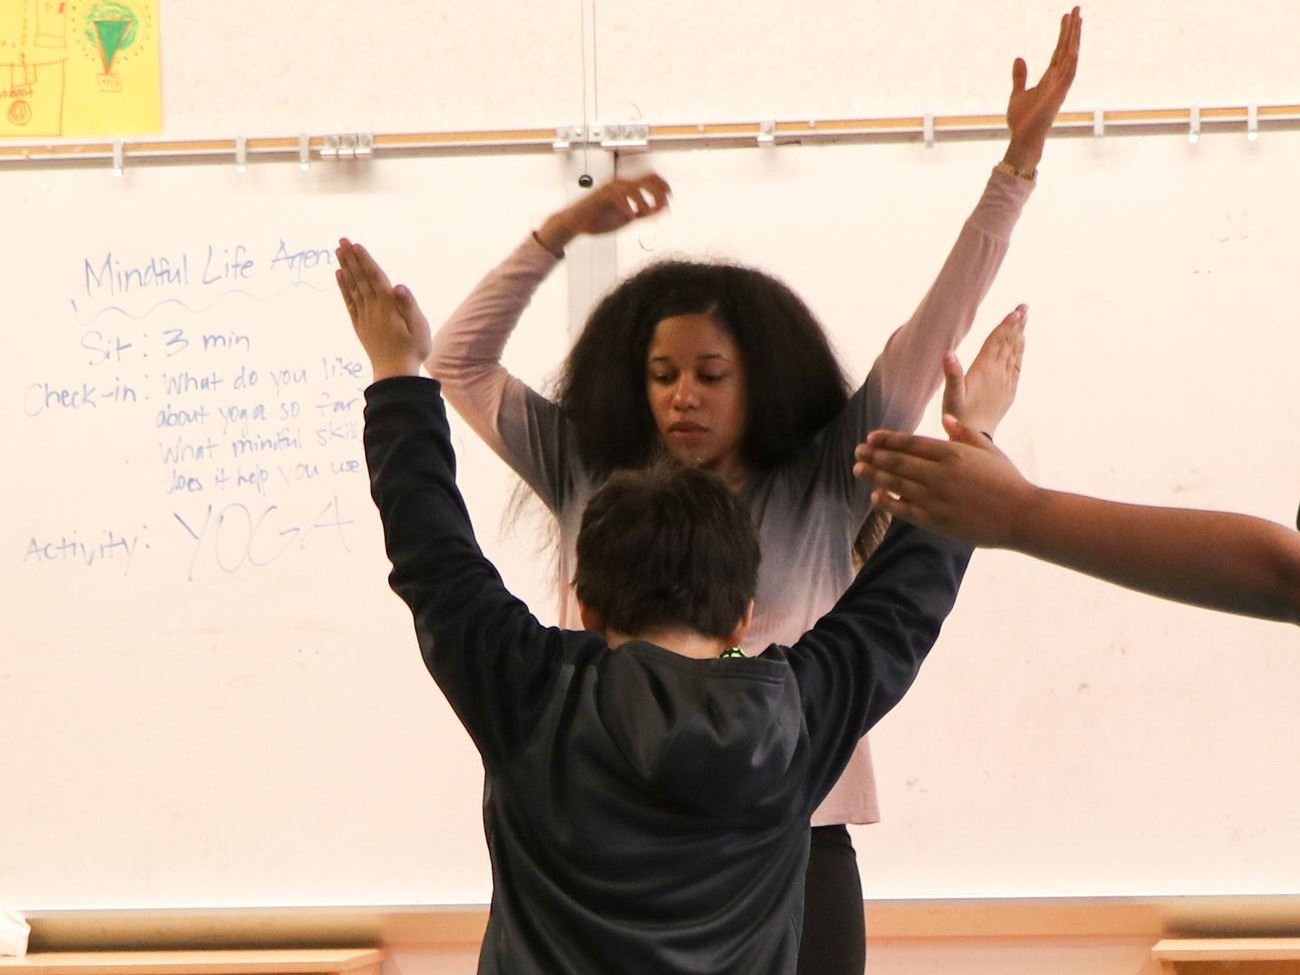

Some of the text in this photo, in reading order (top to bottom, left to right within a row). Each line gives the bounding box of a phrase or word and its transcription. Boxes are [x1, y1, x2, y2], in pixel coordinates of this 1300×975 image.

[85, 239, 336, 297] Mindful Life Agen
[161, 328, 190, 357] 3
[202, 332, 251, 352] min
[233, 365, 259, 389] do
[270, 368, 308, 392] you
[321, 356, 365, 382] like
[156, 403, 210, 428] about
[218, 402, 267, 435] yoga
[279, 400, 301, 420] so
[231, 429, 303, 457] mindful
[214, 467, 230, 488] it
[237, 464, 269, 496] help
[172, 495, 356, 582] YOGA
